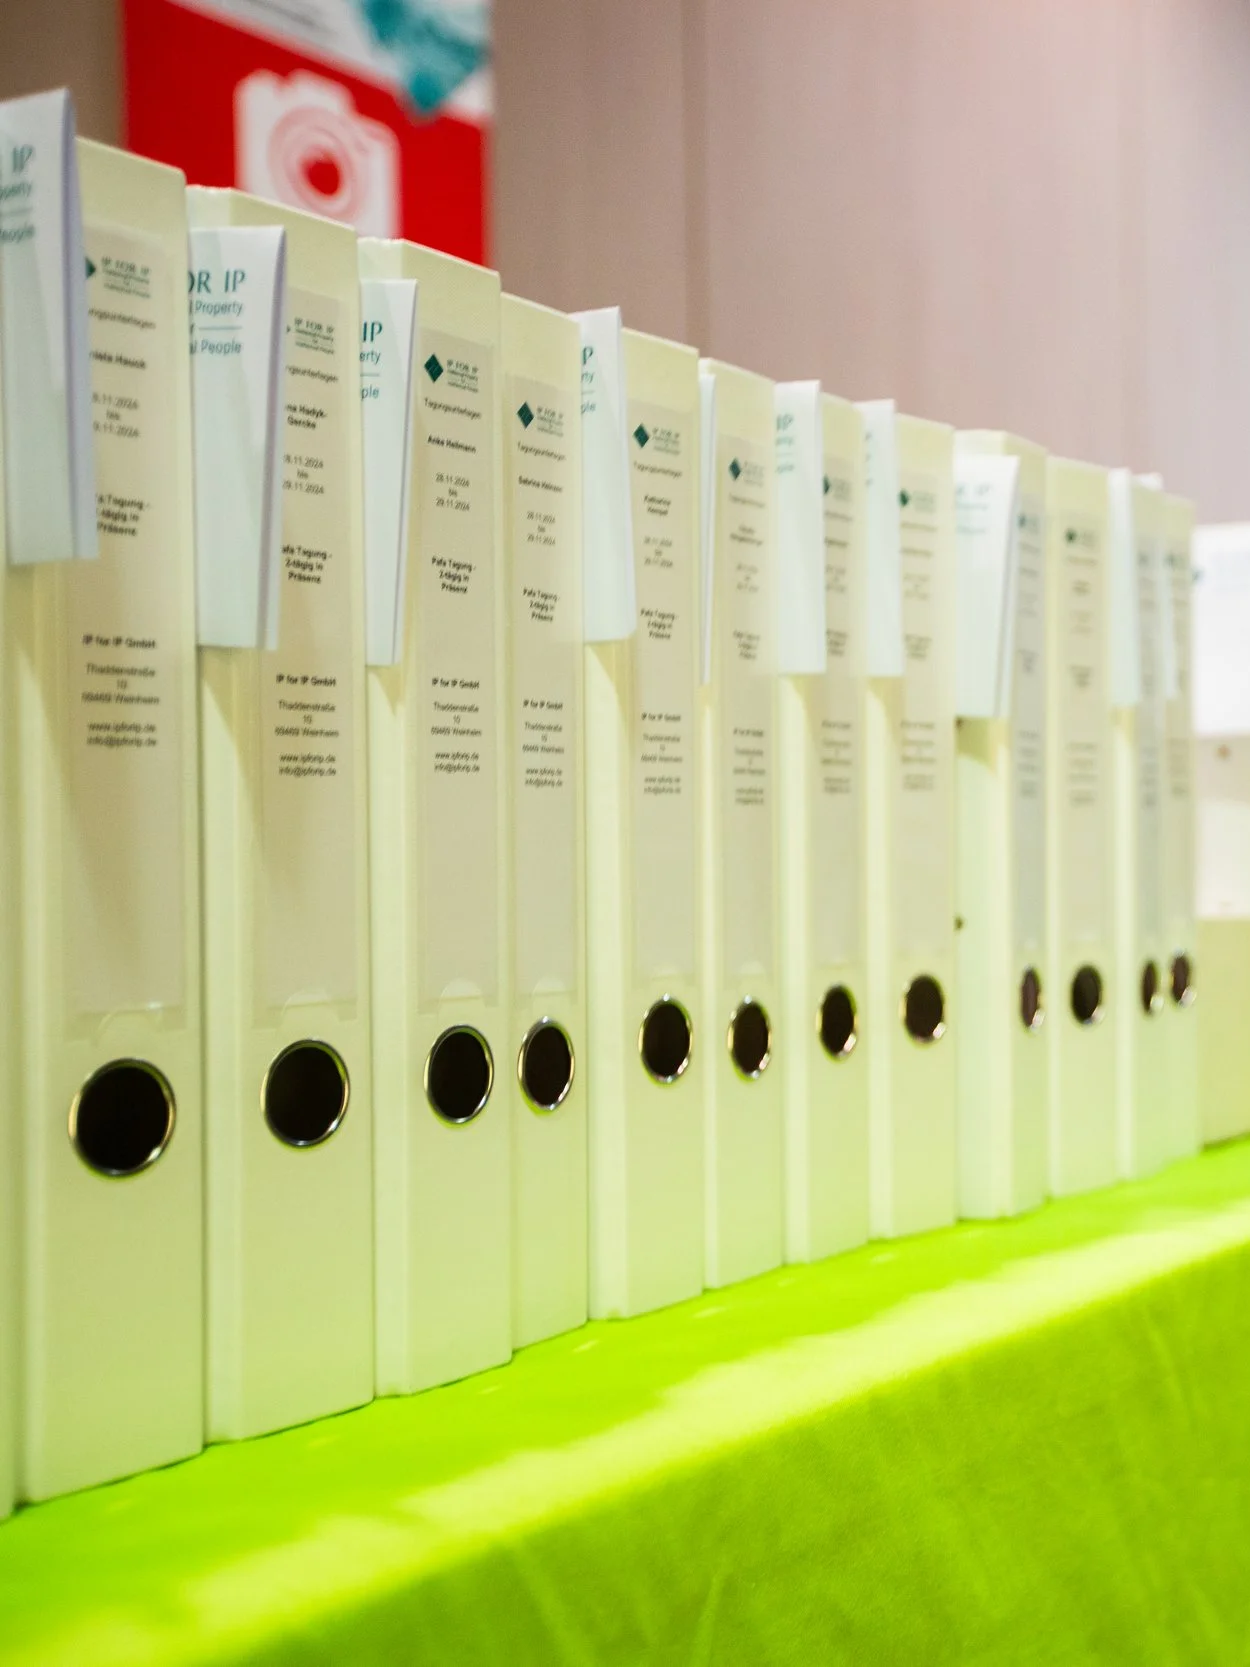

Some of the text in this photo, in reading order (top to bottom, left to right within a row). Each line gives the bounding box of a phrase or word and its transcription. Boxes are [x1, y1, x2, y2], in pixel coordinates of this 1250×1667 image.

[224, 269, 246, 293] IP
[195, 299, 243, 317] Property
[295, 317, 334, 333] IP FOR IP
[362, 320, 383, 342] IP
[201, 339, 241, 355] People
[360, 350, 381, 364] erty
[361, 384, 379, 400] ple
[93, 391, 139, 410] 8.11.2024
[93, 420, 140, 438] 9.11.2024
[106, 494, 144, 511] Tagung
[297, 545, 327, 560] Tagung
[316, 562, 323, 571] in
[448, 558, 472, 573] Tagung
[288, 571, 321, 585] Präsenz
[83, 634, 155, 649] IP for IP GmbH
[276, 673, 336, 687] IP for IP GmbH
